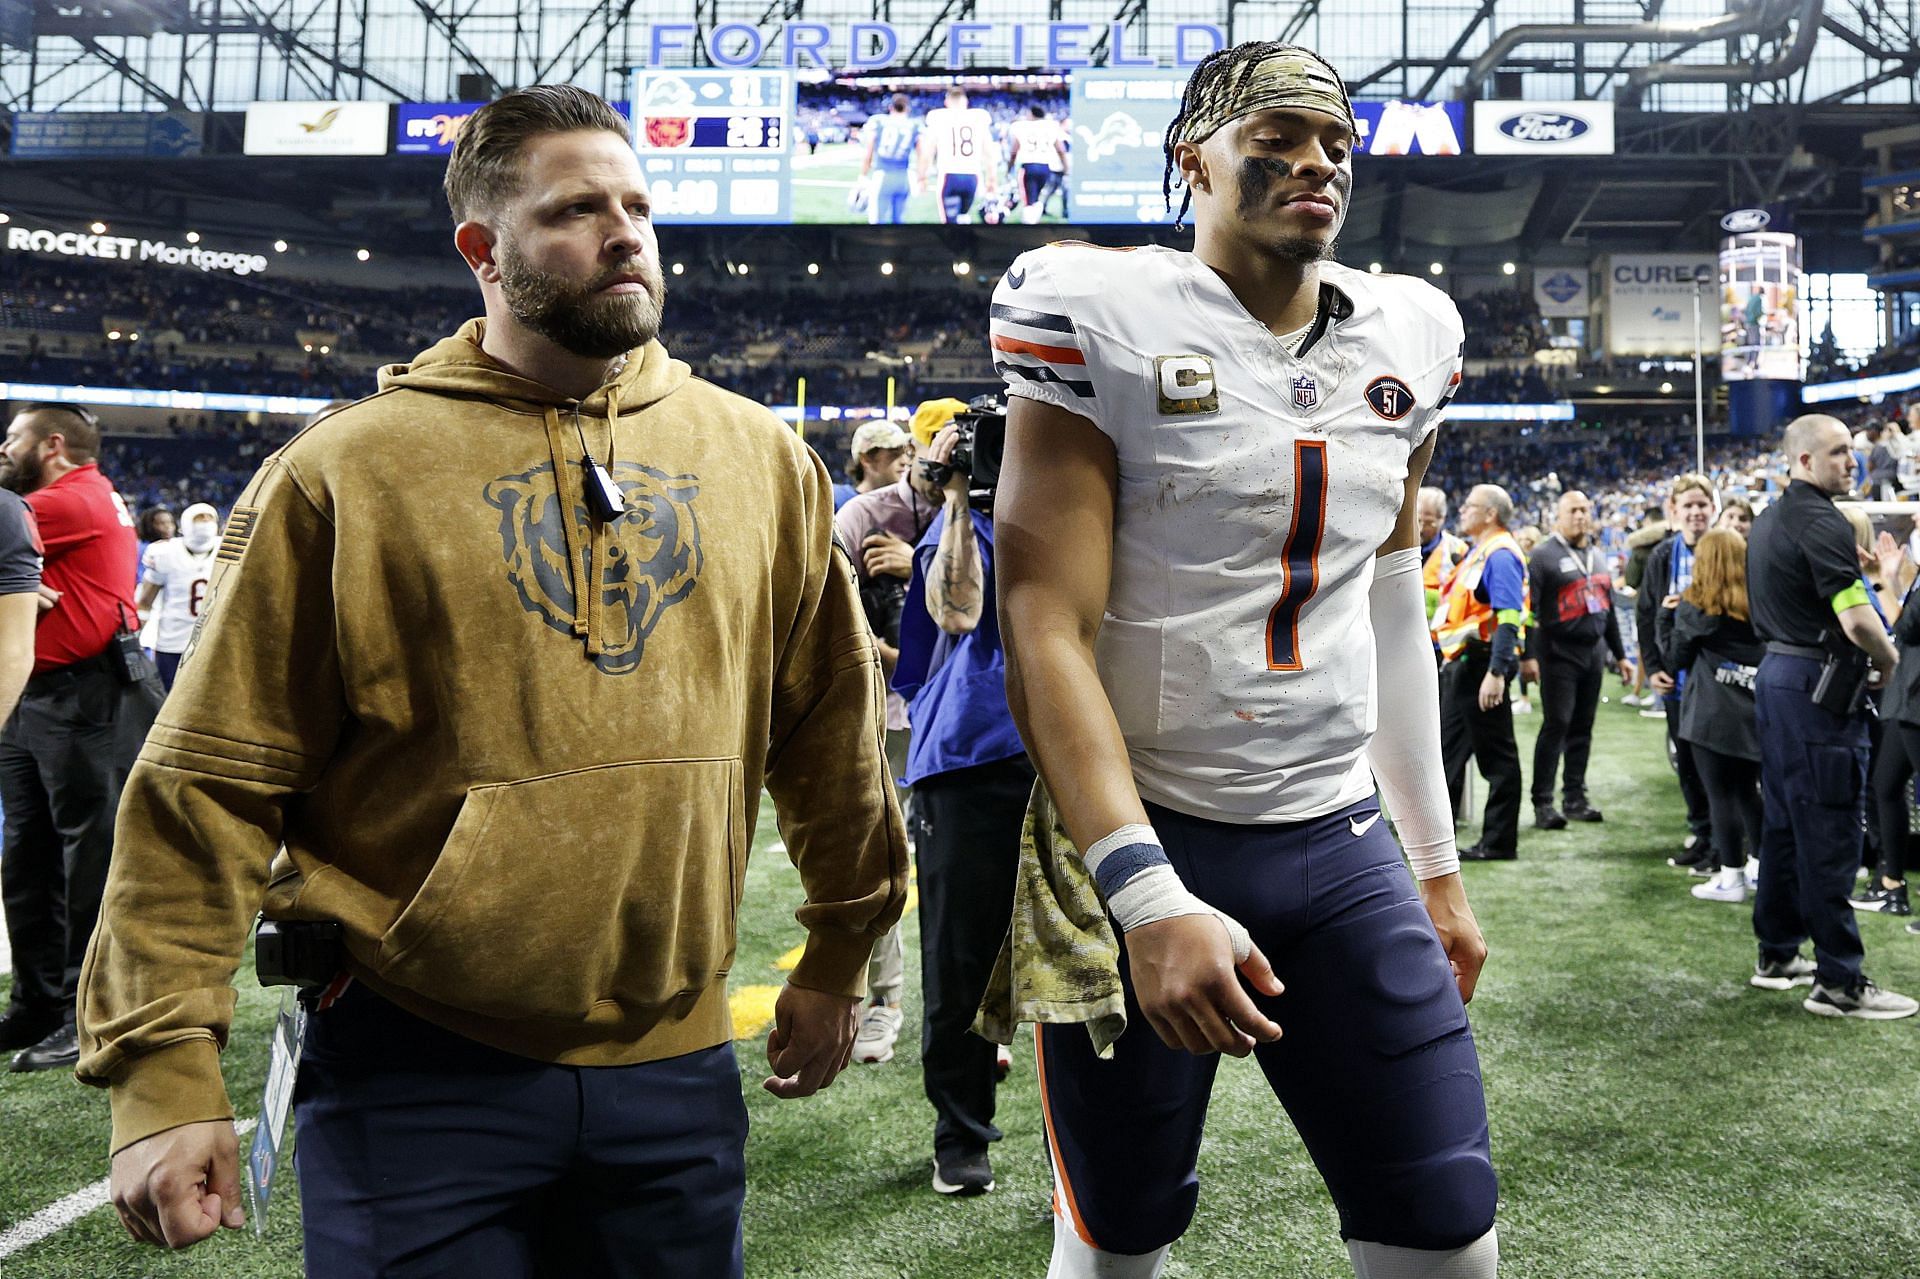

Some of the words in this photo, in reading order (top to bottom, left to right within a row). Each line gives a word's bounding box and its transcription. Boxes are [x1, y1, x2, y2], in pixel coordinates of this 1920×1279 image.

[648, 21, 898, 67] FORD
[948, 21, 1225, 68] FIELD
[952, 125, 974, 157] 18
[1512, 114, 1574, 140] Ford
[7, 226, 138, 261] ROCKET
[139, 239, 268, 276] Mortgage
[1161, 358, 1213, 400] C
[1295, 388, 1315, 404] NFL
[1383, 389, 1399, 416] 51
[1266, 439, 1328, 672] 1
